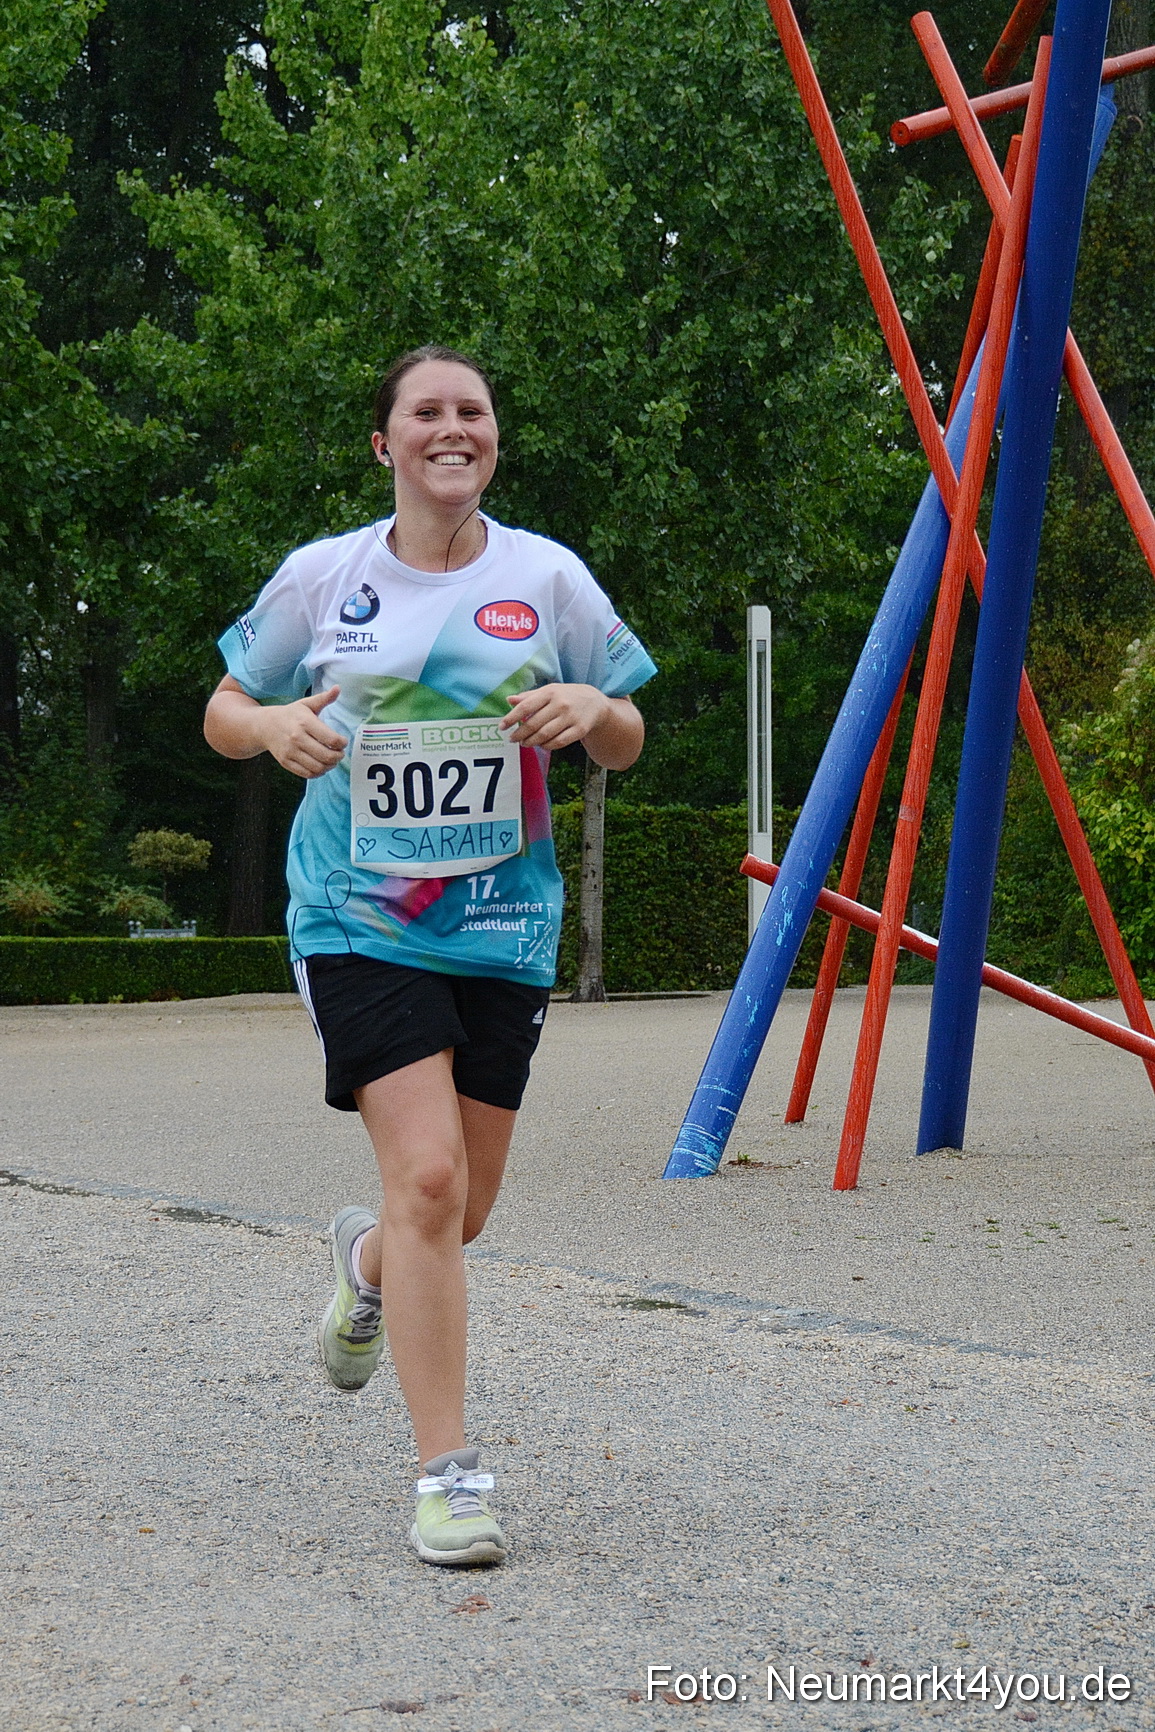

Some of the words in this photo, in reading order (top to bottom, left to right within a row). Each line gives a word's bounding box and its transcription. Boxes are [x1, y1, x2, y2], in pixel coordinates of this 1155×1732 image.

[484, 610, 533, 631] Hervis
[239, 614, 257, 650] CK
[335, 631, 379, 645] PARTL
[334, 644, 378, 655] Neumarkt
[609, 635, 638, 664] Neuer
[421, 724, 504, 746] BOCK
[360, 742, 412, 751] NeuerMarkt
[367, 757, 505, 819] 3027
[387, 822, 494, 860] SARAH
[466, 874, 500, 900] 17.
[465, 901, 544, 917] Neumarkter
